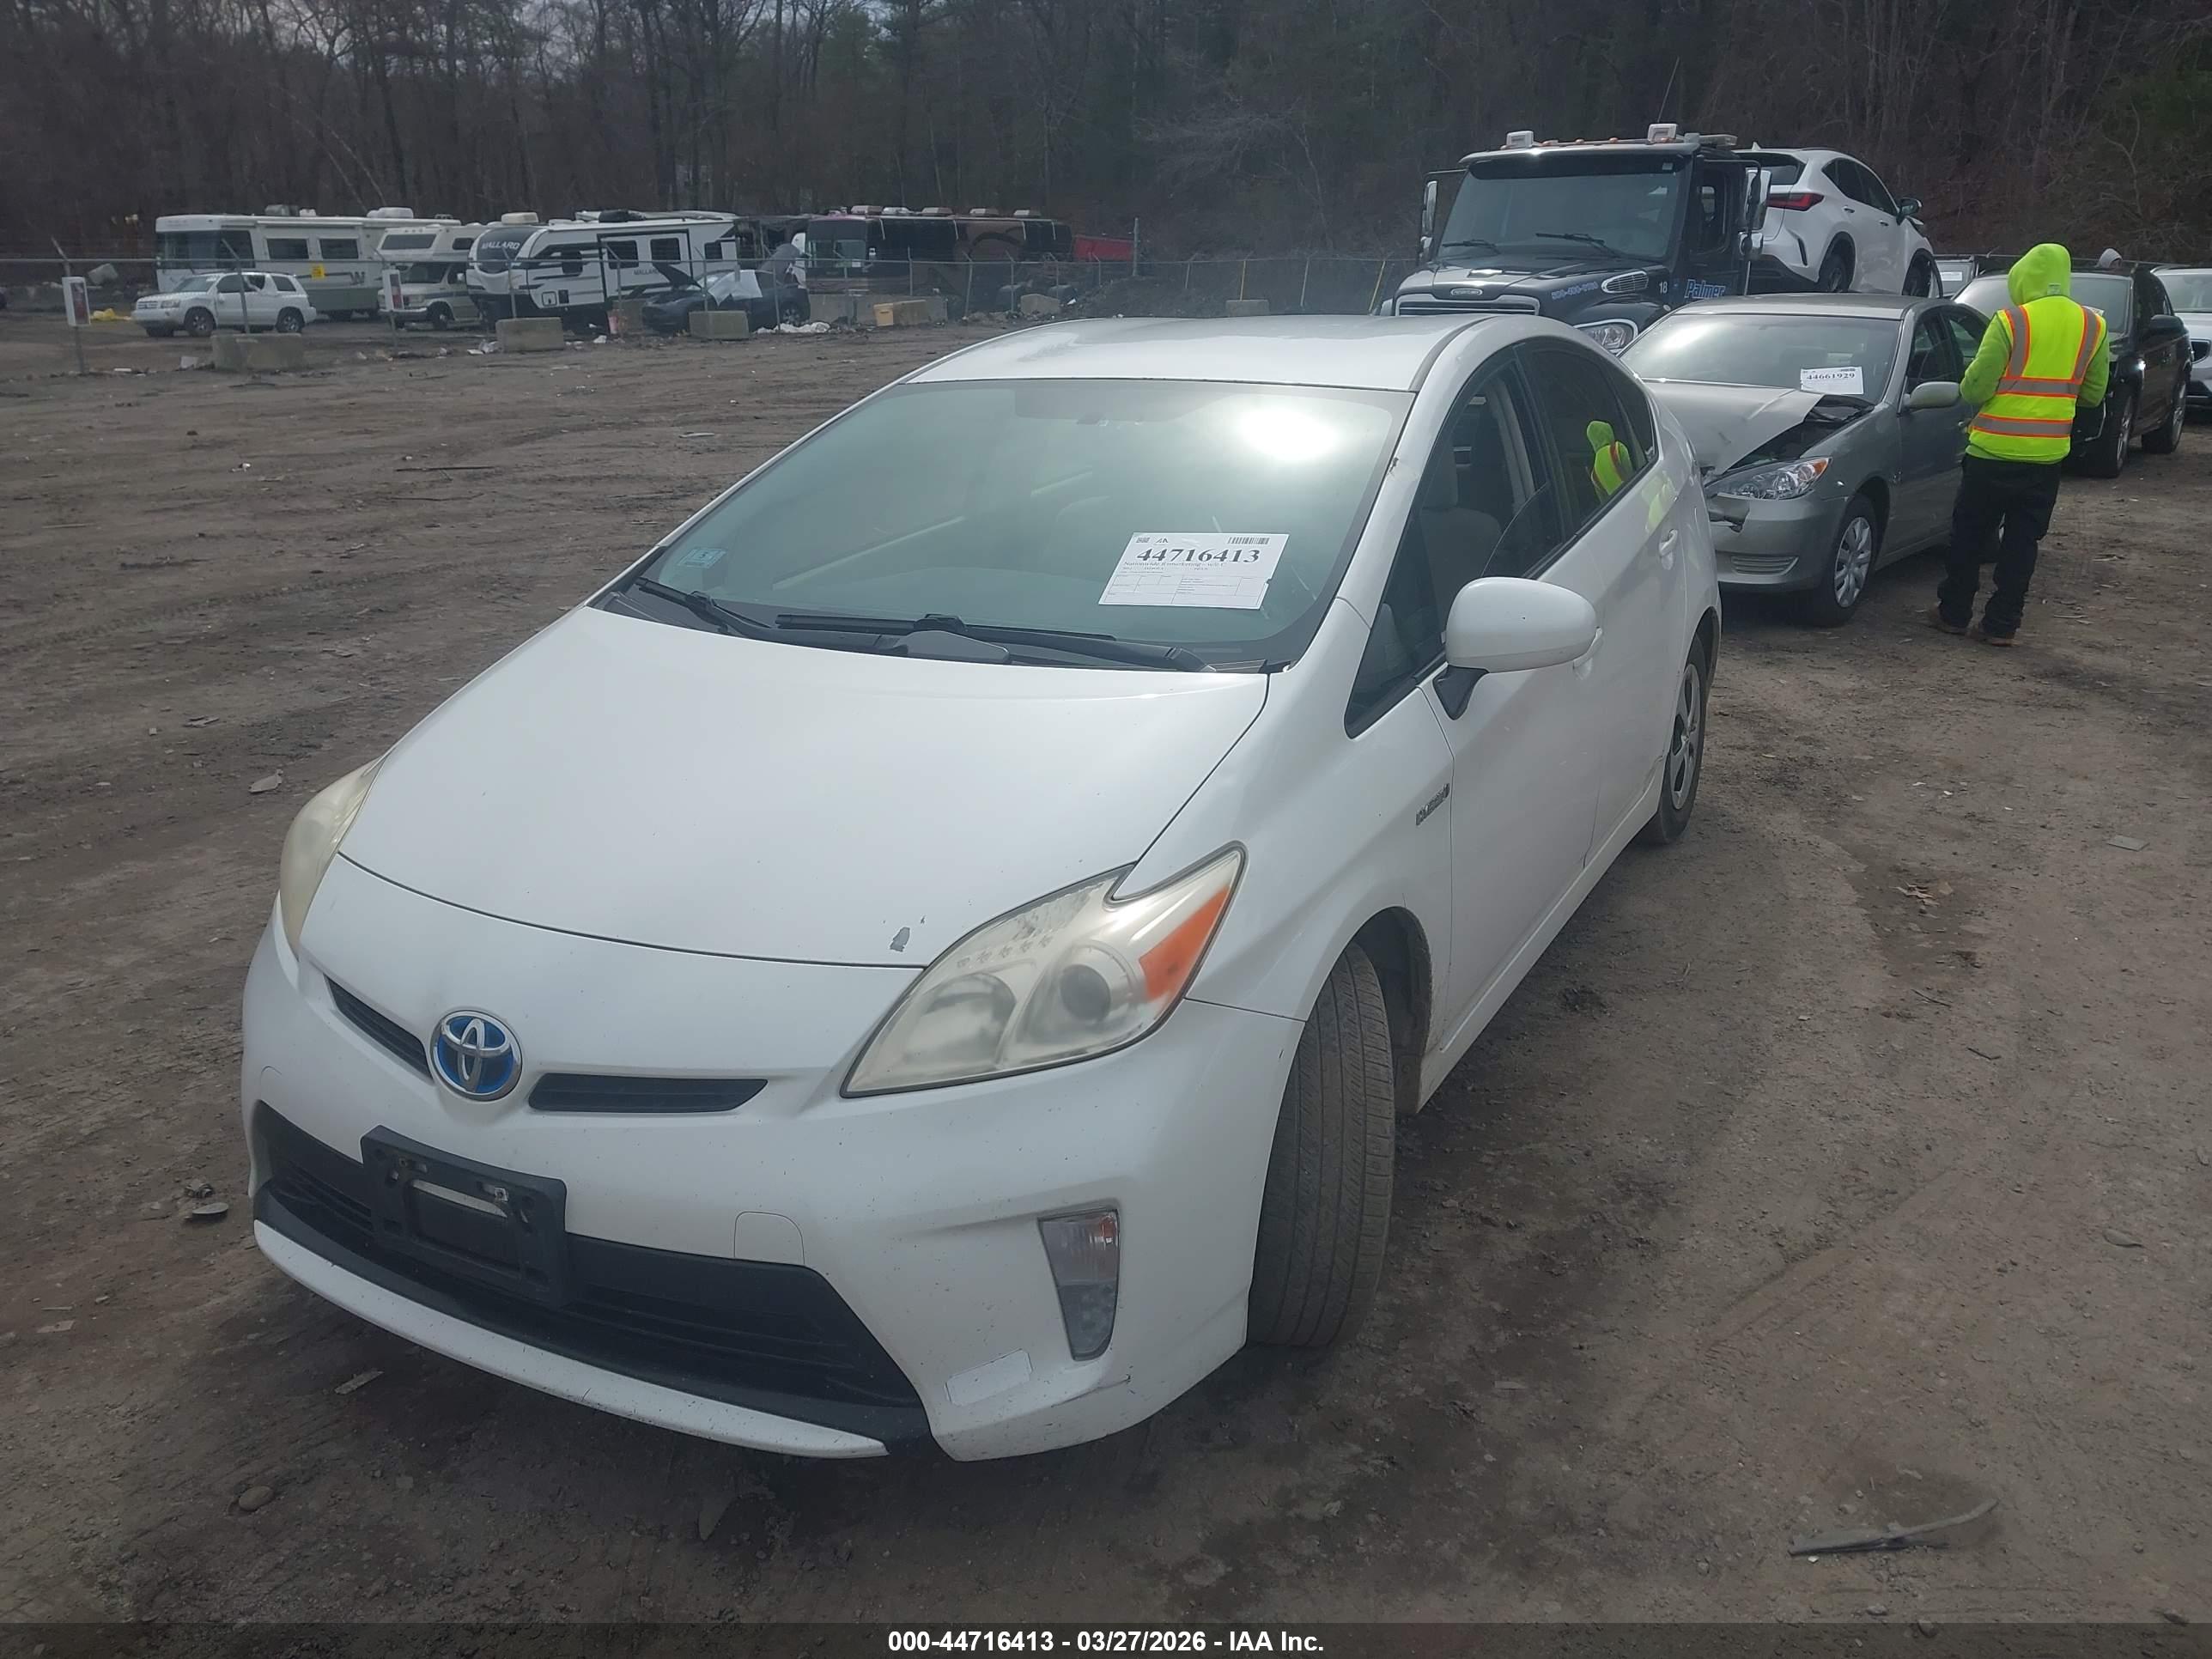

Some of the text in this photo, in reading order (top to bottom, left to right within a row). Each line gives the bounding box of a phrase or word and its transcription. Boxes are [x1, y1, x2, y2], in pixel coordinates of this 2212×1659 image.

[1659, 281, 1668, 294] 18
[1684, 279, 1726, 299] Palmer
[1137, 548, 1261, 563] 44716413
